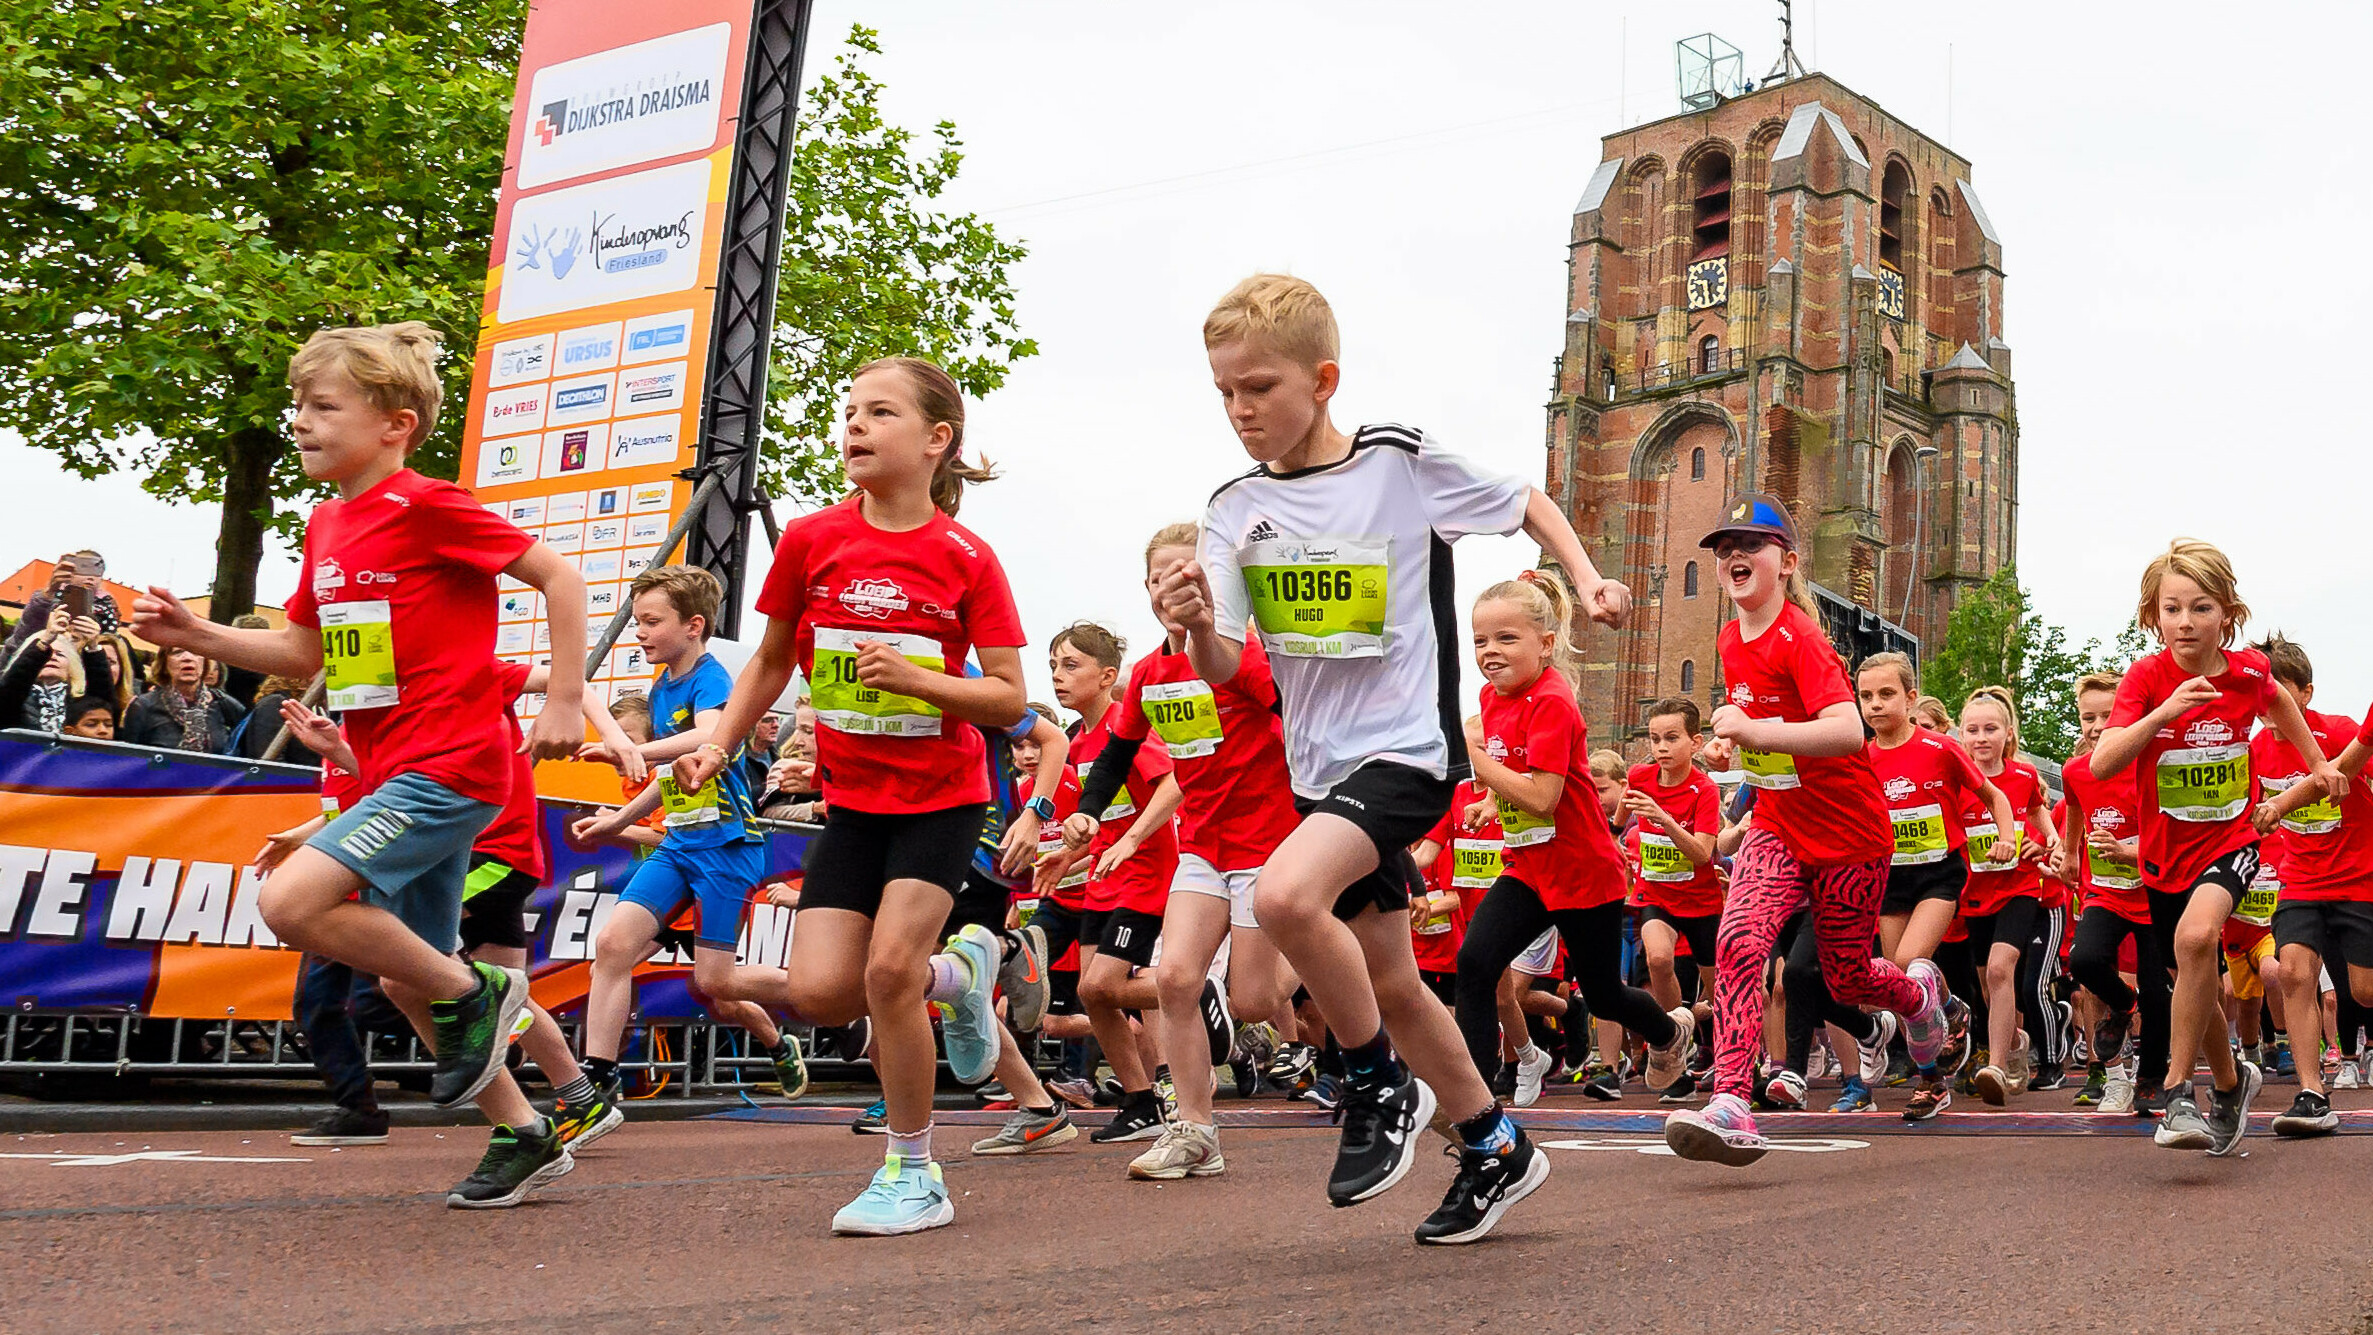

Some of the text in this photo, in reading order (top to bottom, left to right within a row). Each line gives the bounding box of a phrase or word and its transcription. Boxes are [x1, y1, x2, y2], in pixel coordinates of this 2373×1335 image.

[568, 79, 709, 133] DIJKSTRA DRAISMA
[590, 210, 694, 269] Kinderopvang
[608, 251, 663, 270] Friesland
[564, 340, 613, 364] URSUS
[515, 400, 538, 413] VRIES
[1266, 570, 1351, 602] 10366
[1294, 608, 1323, 621] HUGO
[324, 629, 360, 658] 410
[830, 656, 857, 684] 10
[856, 690, 880, 703] LISE
[2178, 762, 2236, 787] 10281
[1335, 795, 1364, 810] KIPSTA
[2203, 790, 2219, 799] IAN
[1892, 820, 1928, 839] 0468
[1461, 851, 1495, 865] 10587
[1645, 845, 1679, 861] 10205
[106, 855, 288, 947] HAK
[1115, 926, 1132, 948] 10
